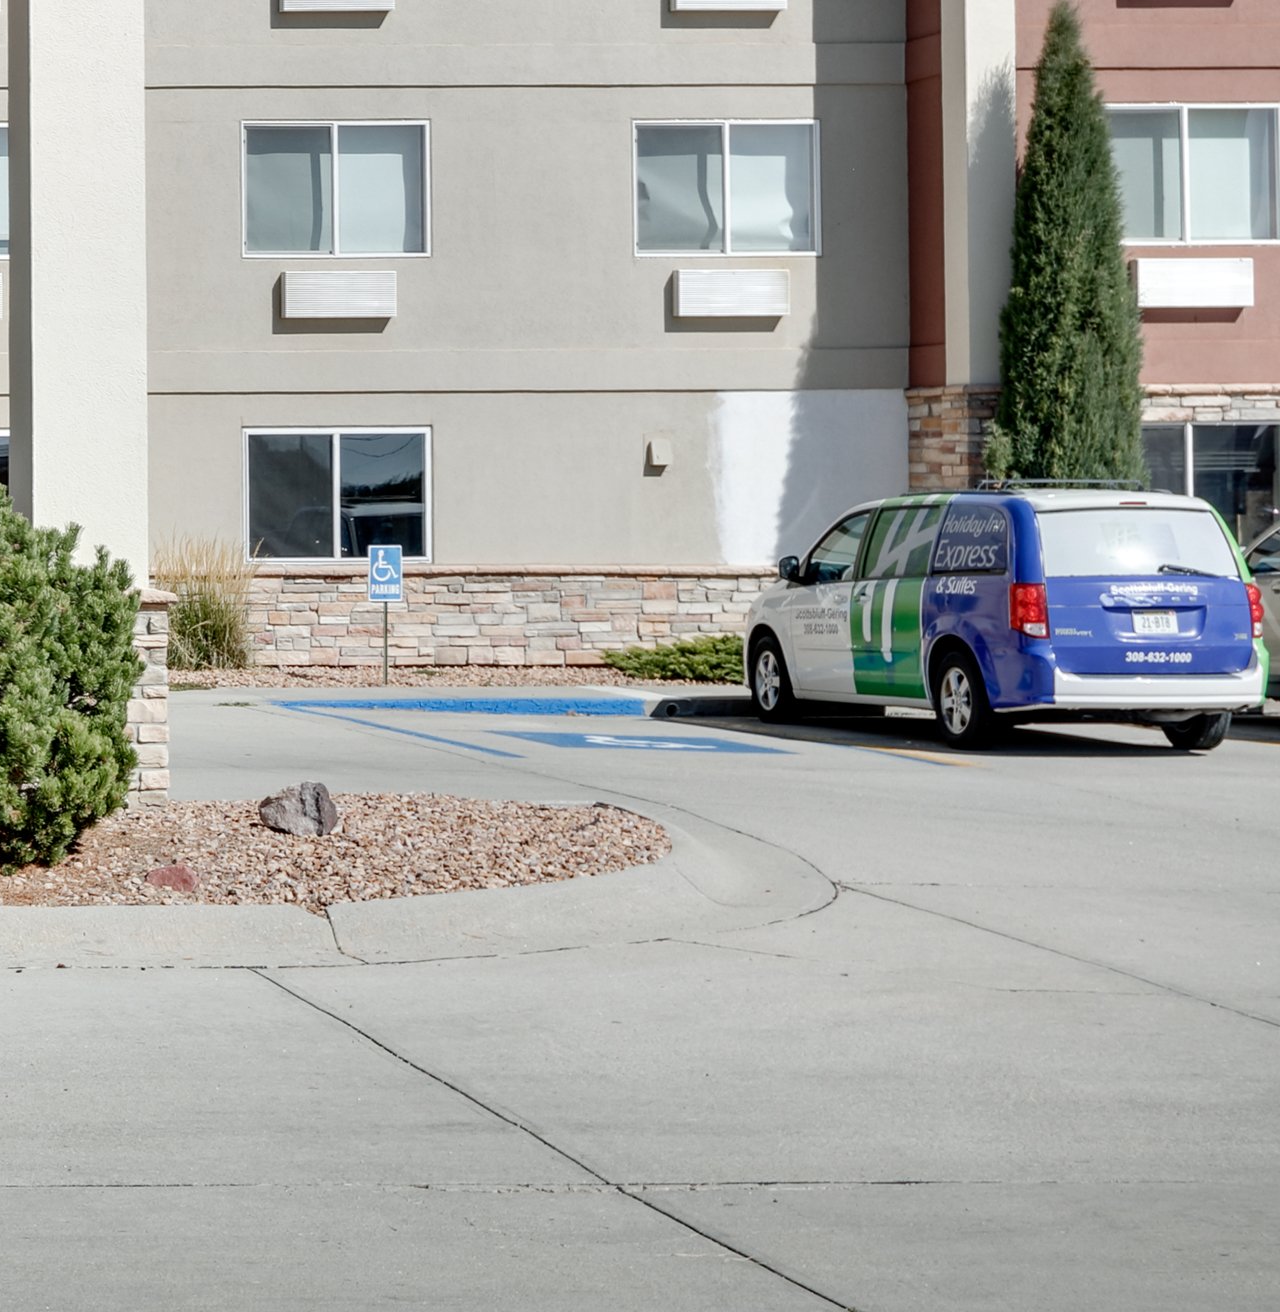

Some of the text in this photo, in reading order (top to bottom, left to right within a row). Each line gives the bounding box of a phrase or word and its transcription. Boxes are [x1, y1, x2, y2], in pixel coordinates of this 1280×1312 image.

[942, 513, 1006, 538] Holiday Inn
[934, 539, 999, 571] Express
[371, 584, 400, 595] PARKING
[935, 576, 978, 595] & Suites
[1125, 651, 1193, 663] 308-632-1000
